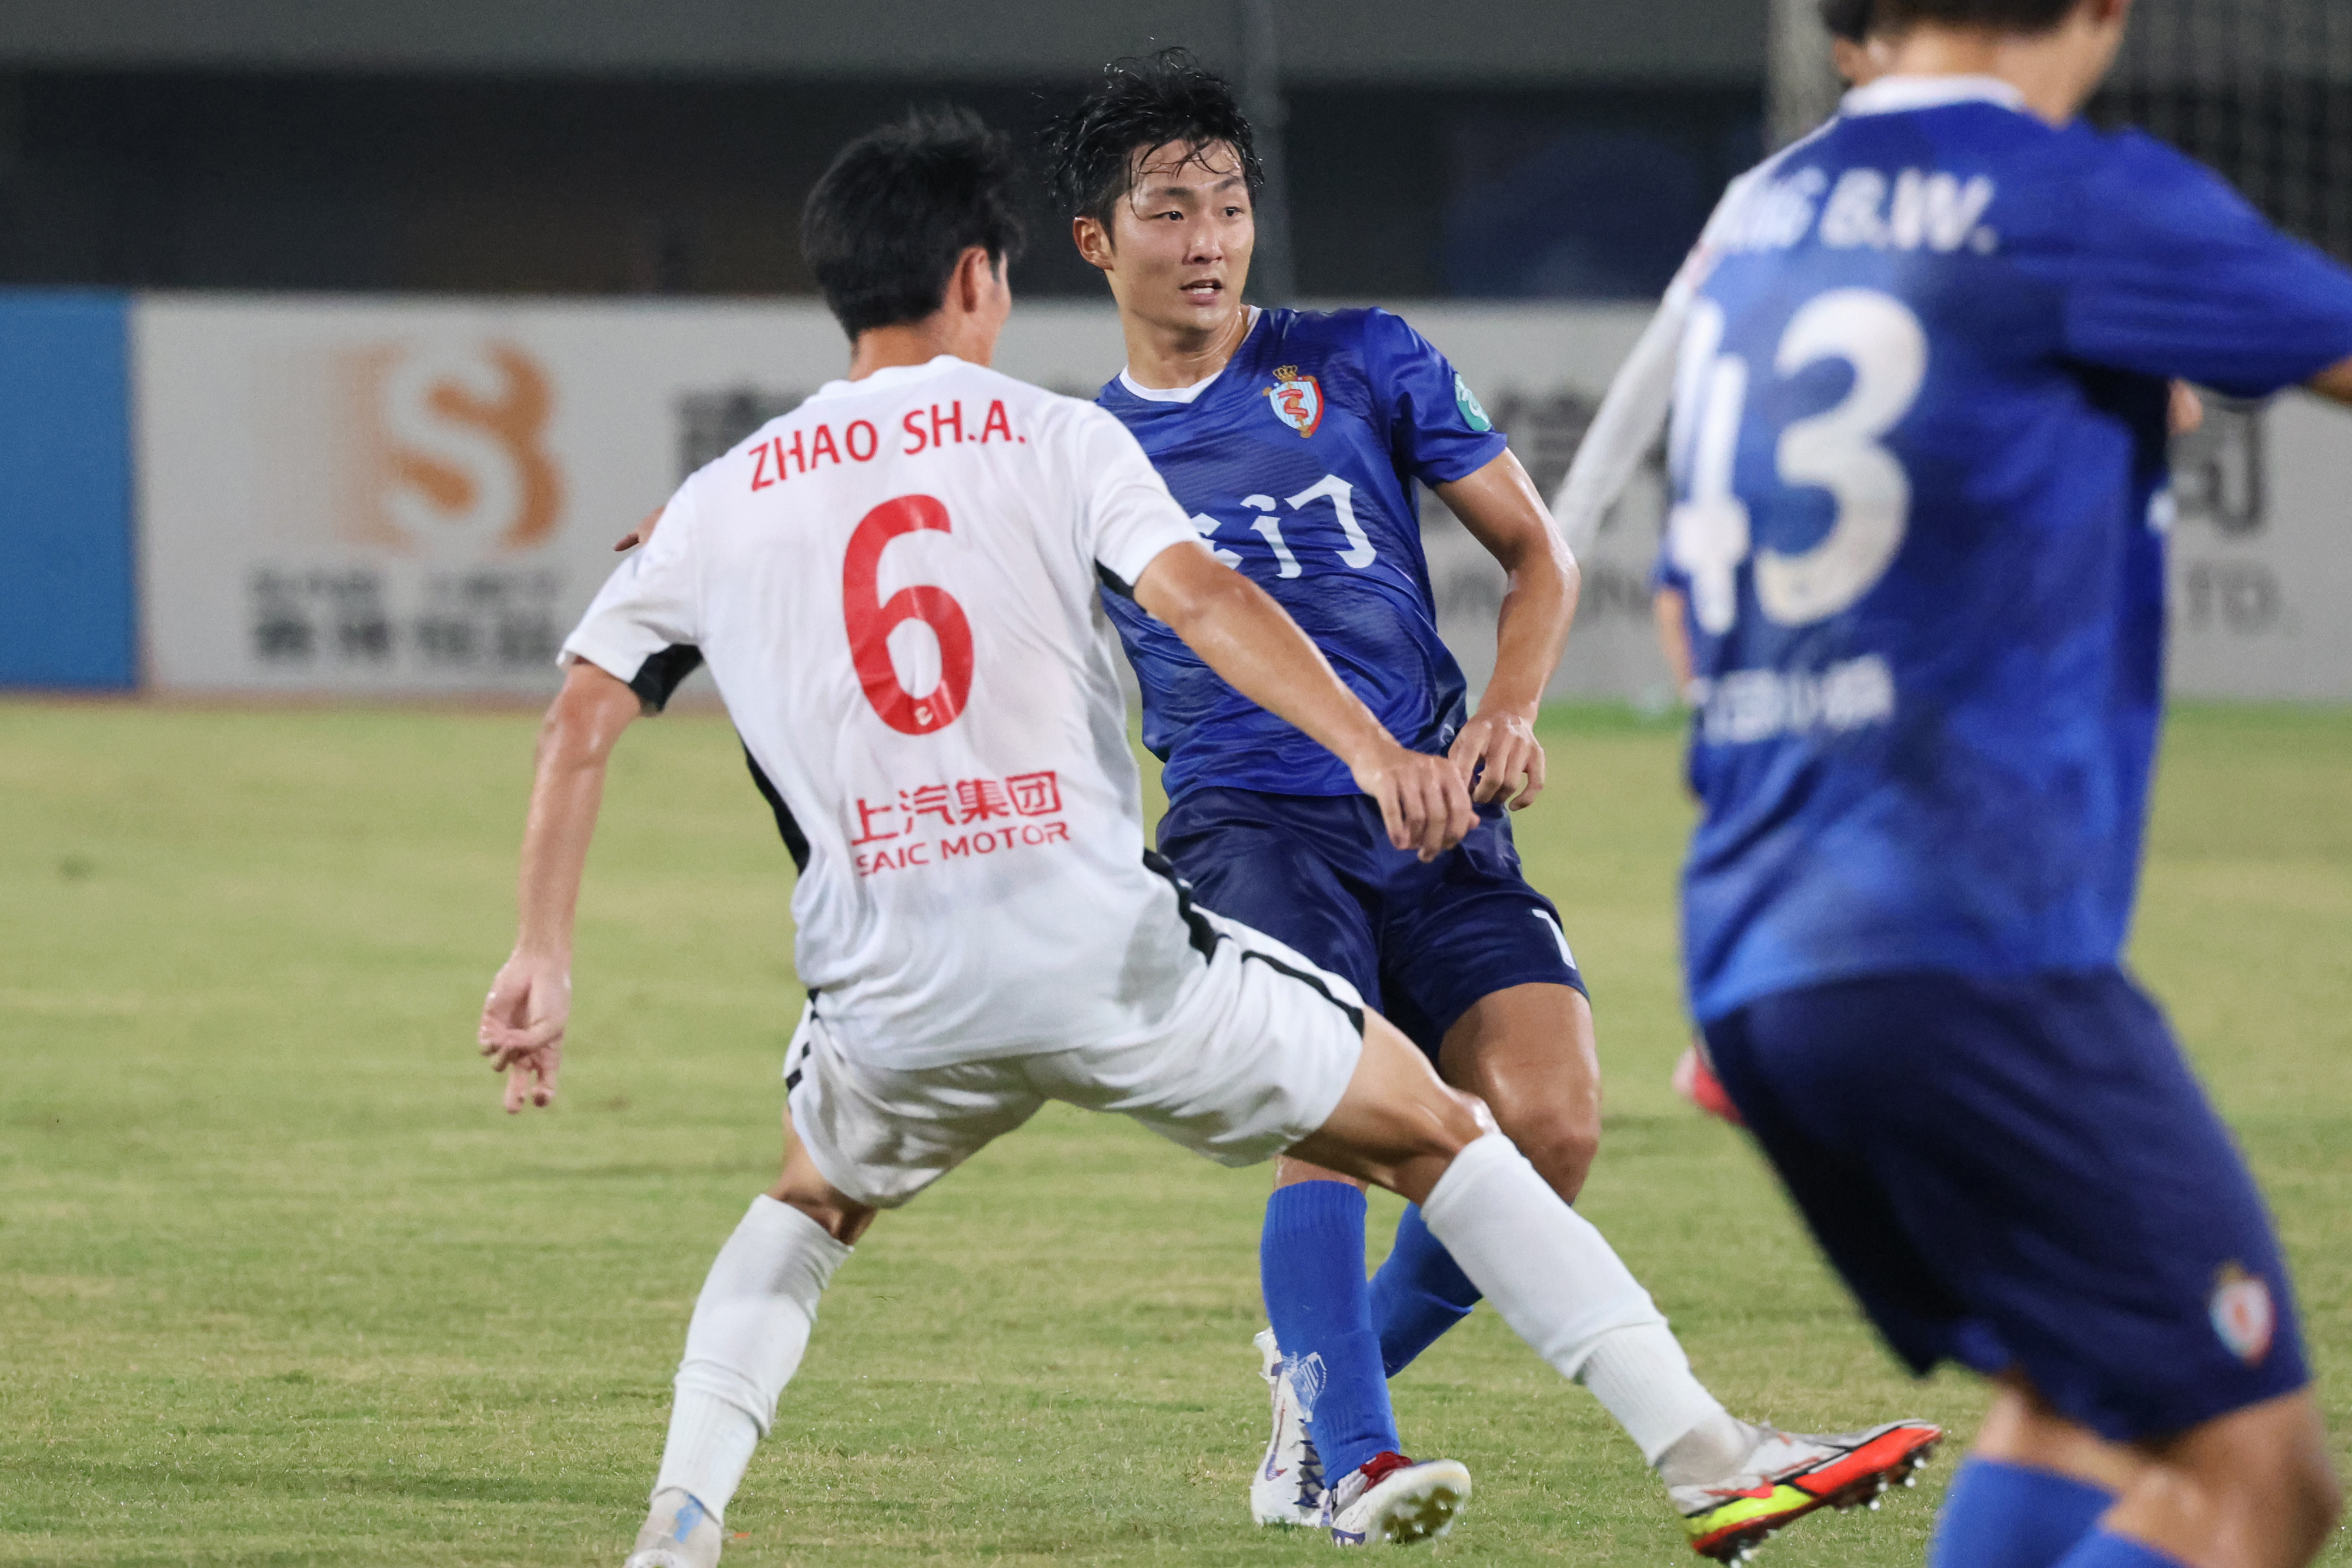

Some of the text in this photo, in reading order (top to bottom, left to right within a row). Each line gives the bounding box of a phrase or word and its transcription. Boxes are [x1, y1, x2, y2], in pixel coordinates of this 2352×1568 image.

[749, 419, 879, 492] ZHAO
[902, 399, 1026, 456] SH.A.
[1669, 286, 1930, 636] 43
[841, 493, 975, 737] 6
[851, 771, 1063, 847] 上汽集团
[856, 821, 1070, 877] SAIC MOTOR
